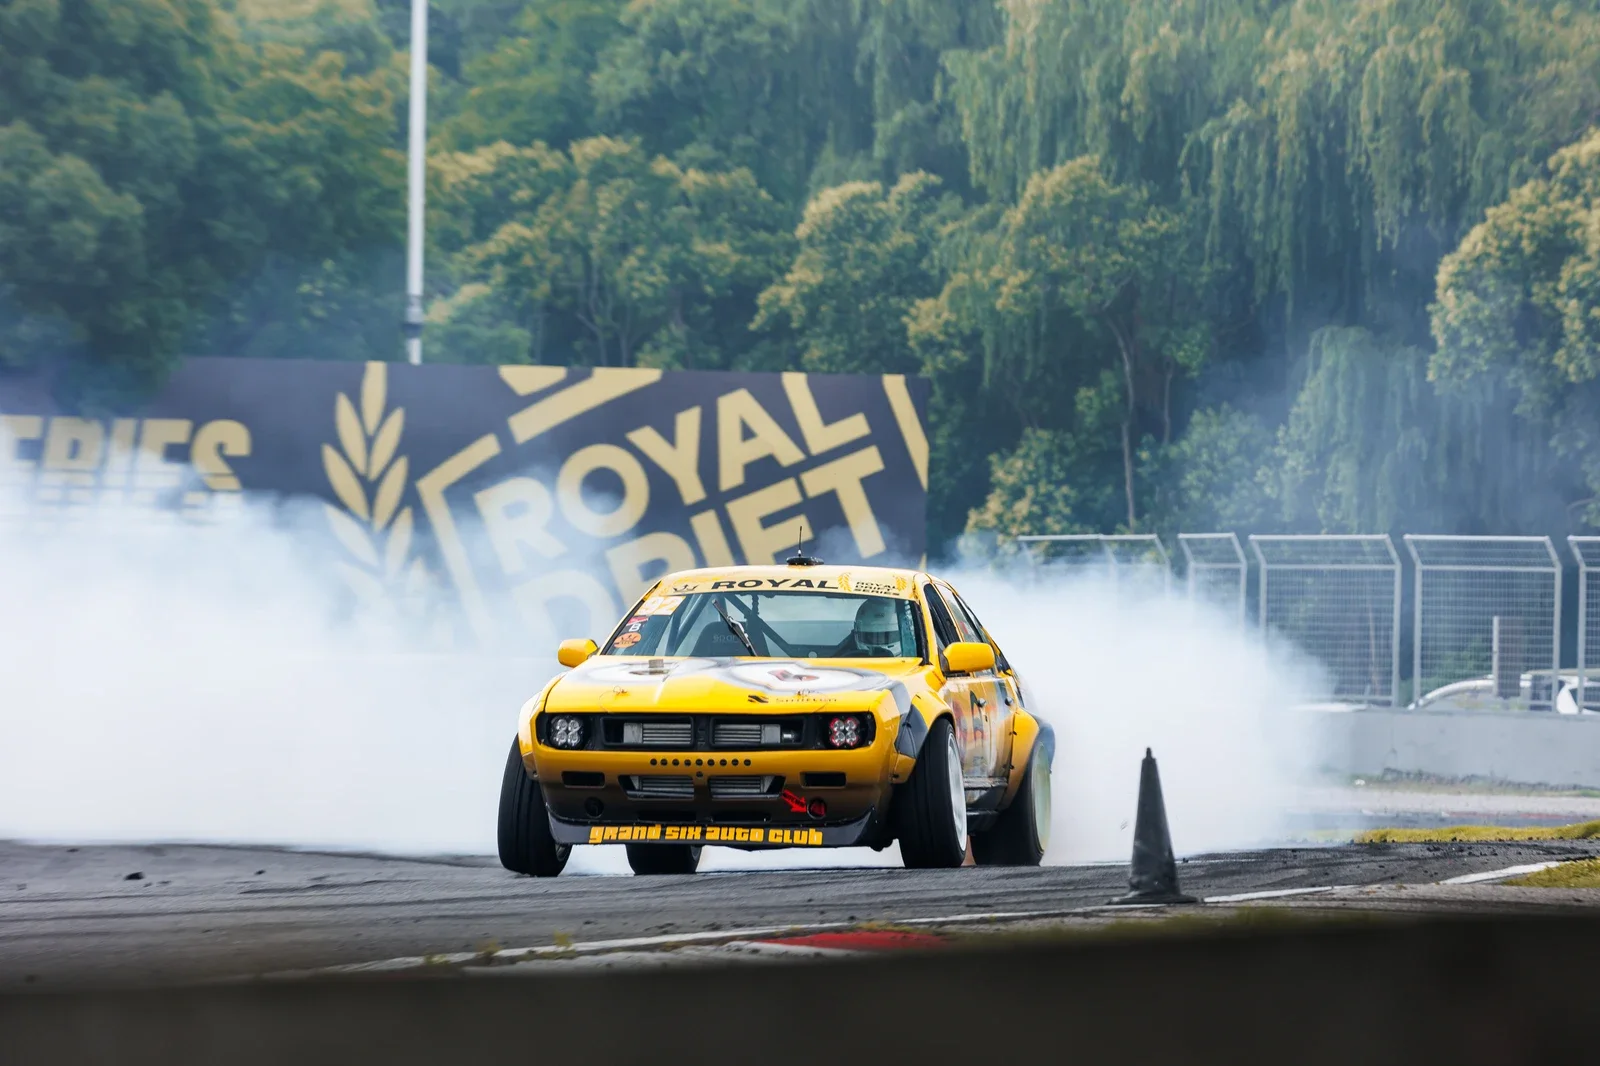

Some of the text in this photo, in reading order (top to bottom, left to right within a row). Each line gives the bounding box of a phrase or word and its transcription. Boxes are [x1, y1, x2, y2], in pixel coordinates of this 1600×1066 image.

[473, 372, 872, 575] ROYAL
[710, 578, 839, 590] ROYAL
[856, 581, 897, 589] ROYAL
[854, 588, 900, 596] SERIES
[628, 622, 642, 632] B
[664, 826, 702, 840] six
[705, 827, 764, 842] auto
[768, 828, 823, 845] club
